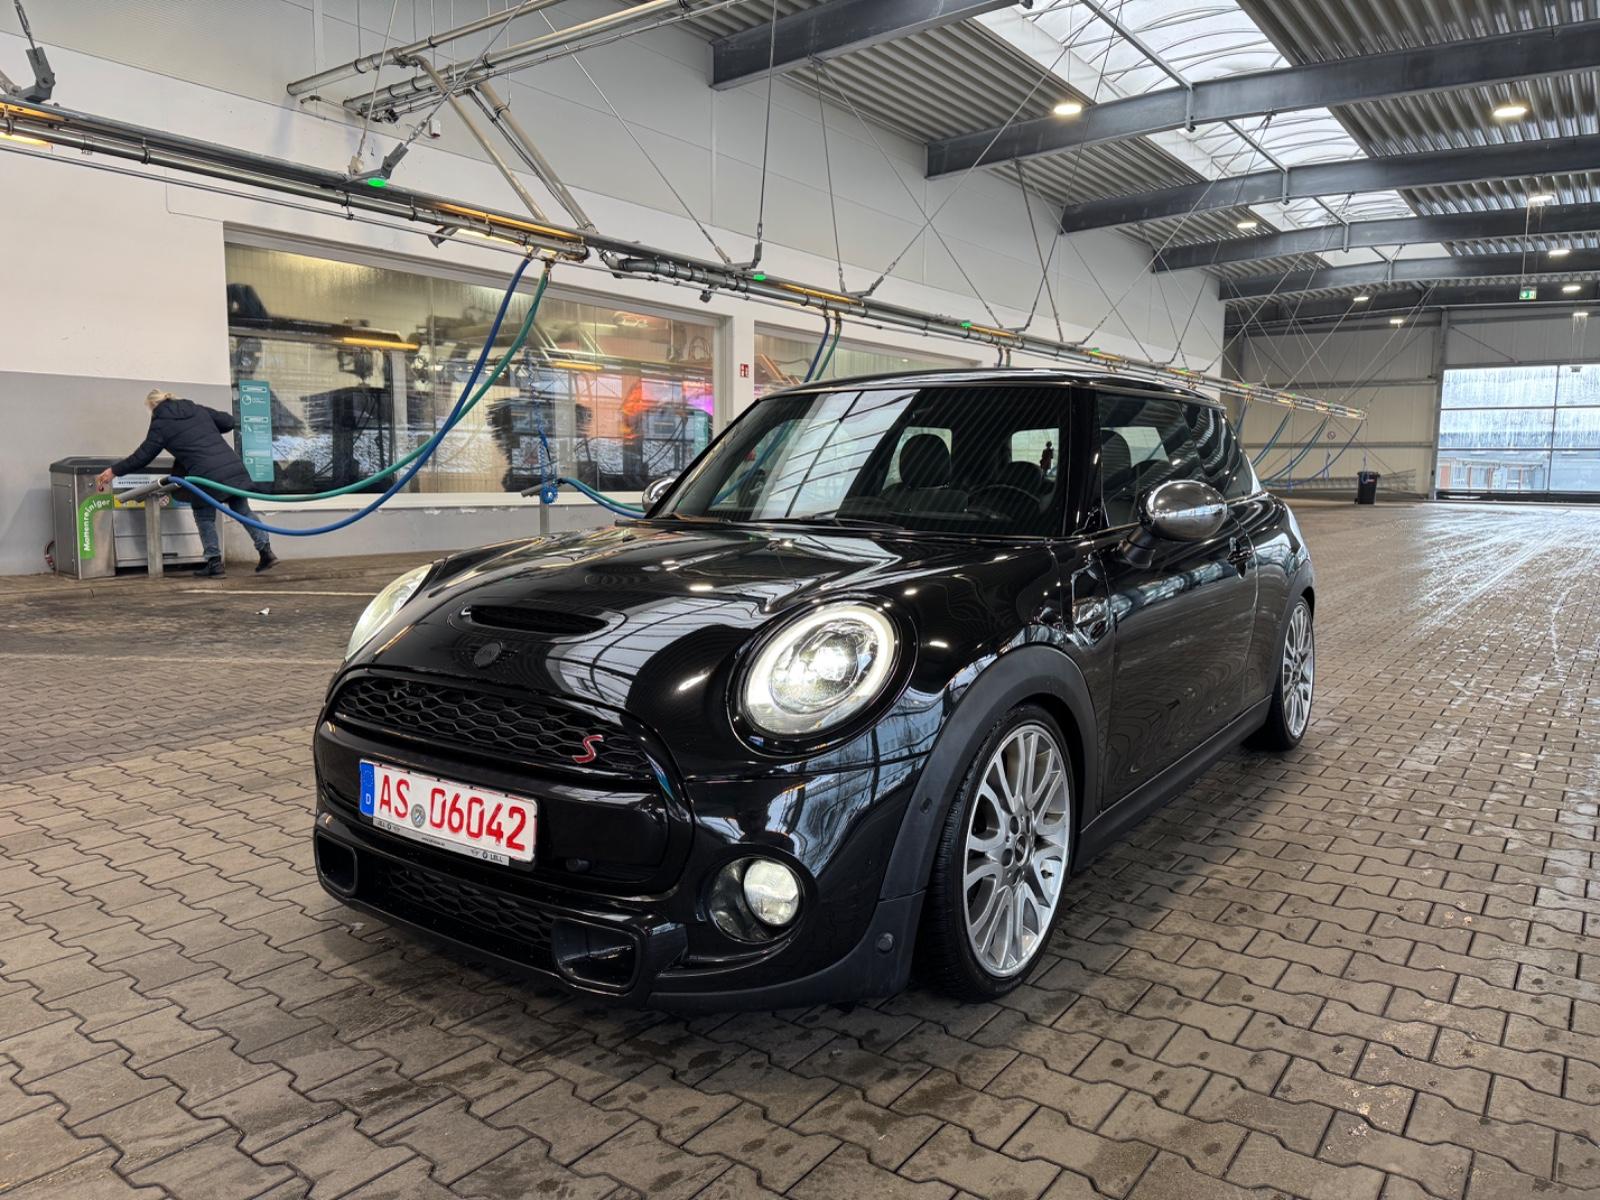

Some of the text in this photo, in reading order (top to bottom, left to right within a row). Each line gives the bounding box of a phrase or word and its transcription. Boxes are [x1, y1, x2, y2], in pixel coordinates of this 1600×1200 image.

[83, 499, 111, 552] Mattenreiniger
[571, 734, 604, 764] S
[365, 793, 372, 805] D
[379, 774, 527, 851] AS 06042
